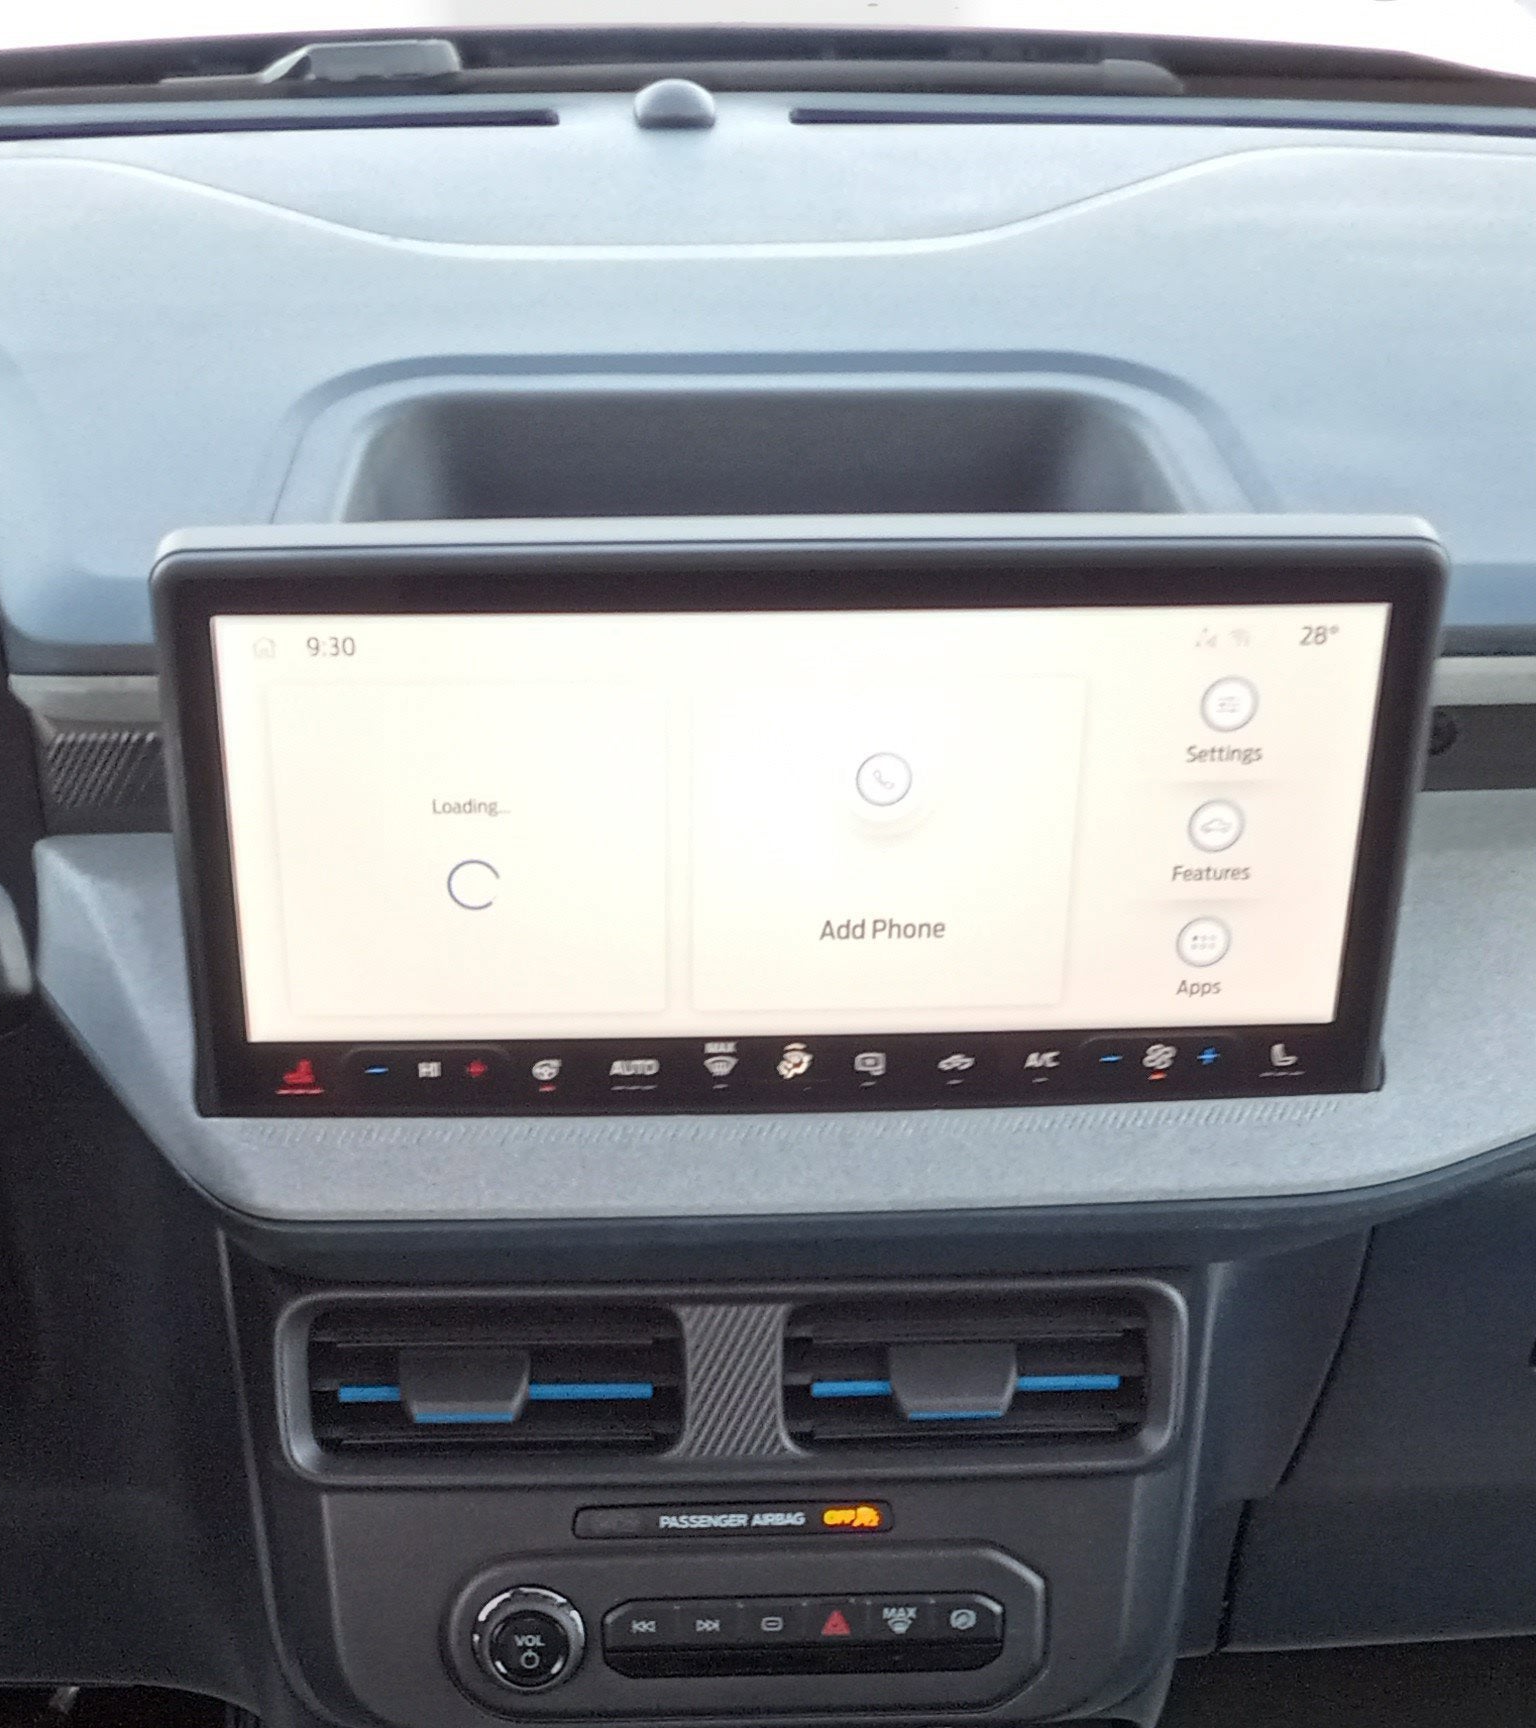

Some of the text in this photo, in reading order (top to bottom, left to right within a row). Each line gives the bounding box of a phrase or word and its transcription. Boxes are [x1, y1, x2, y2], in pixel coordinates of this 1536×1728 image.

[1299, 624, 1339, 646] 28°
[306, 637, 356, 657] 9:30
[1185, 745, 1263, 765] Settings
[1171, 865, 1251, 882] Features
[819, 918, 946, 941] Add Phone
[1176, 980, 1221, 998] Apps
[609, 1059, 660, 1076] AUTO
[1023, 1050, 1061, 1070] A/C
[659, 1513, 748, 1529] PASSENGER
[751, 1511, 805, 1527] AIRBAG
[823, 1509, 856, 1526] OFF
[882, 1606, 918, 1620] MAX
[514, 1634, 546, 1647] VOL
